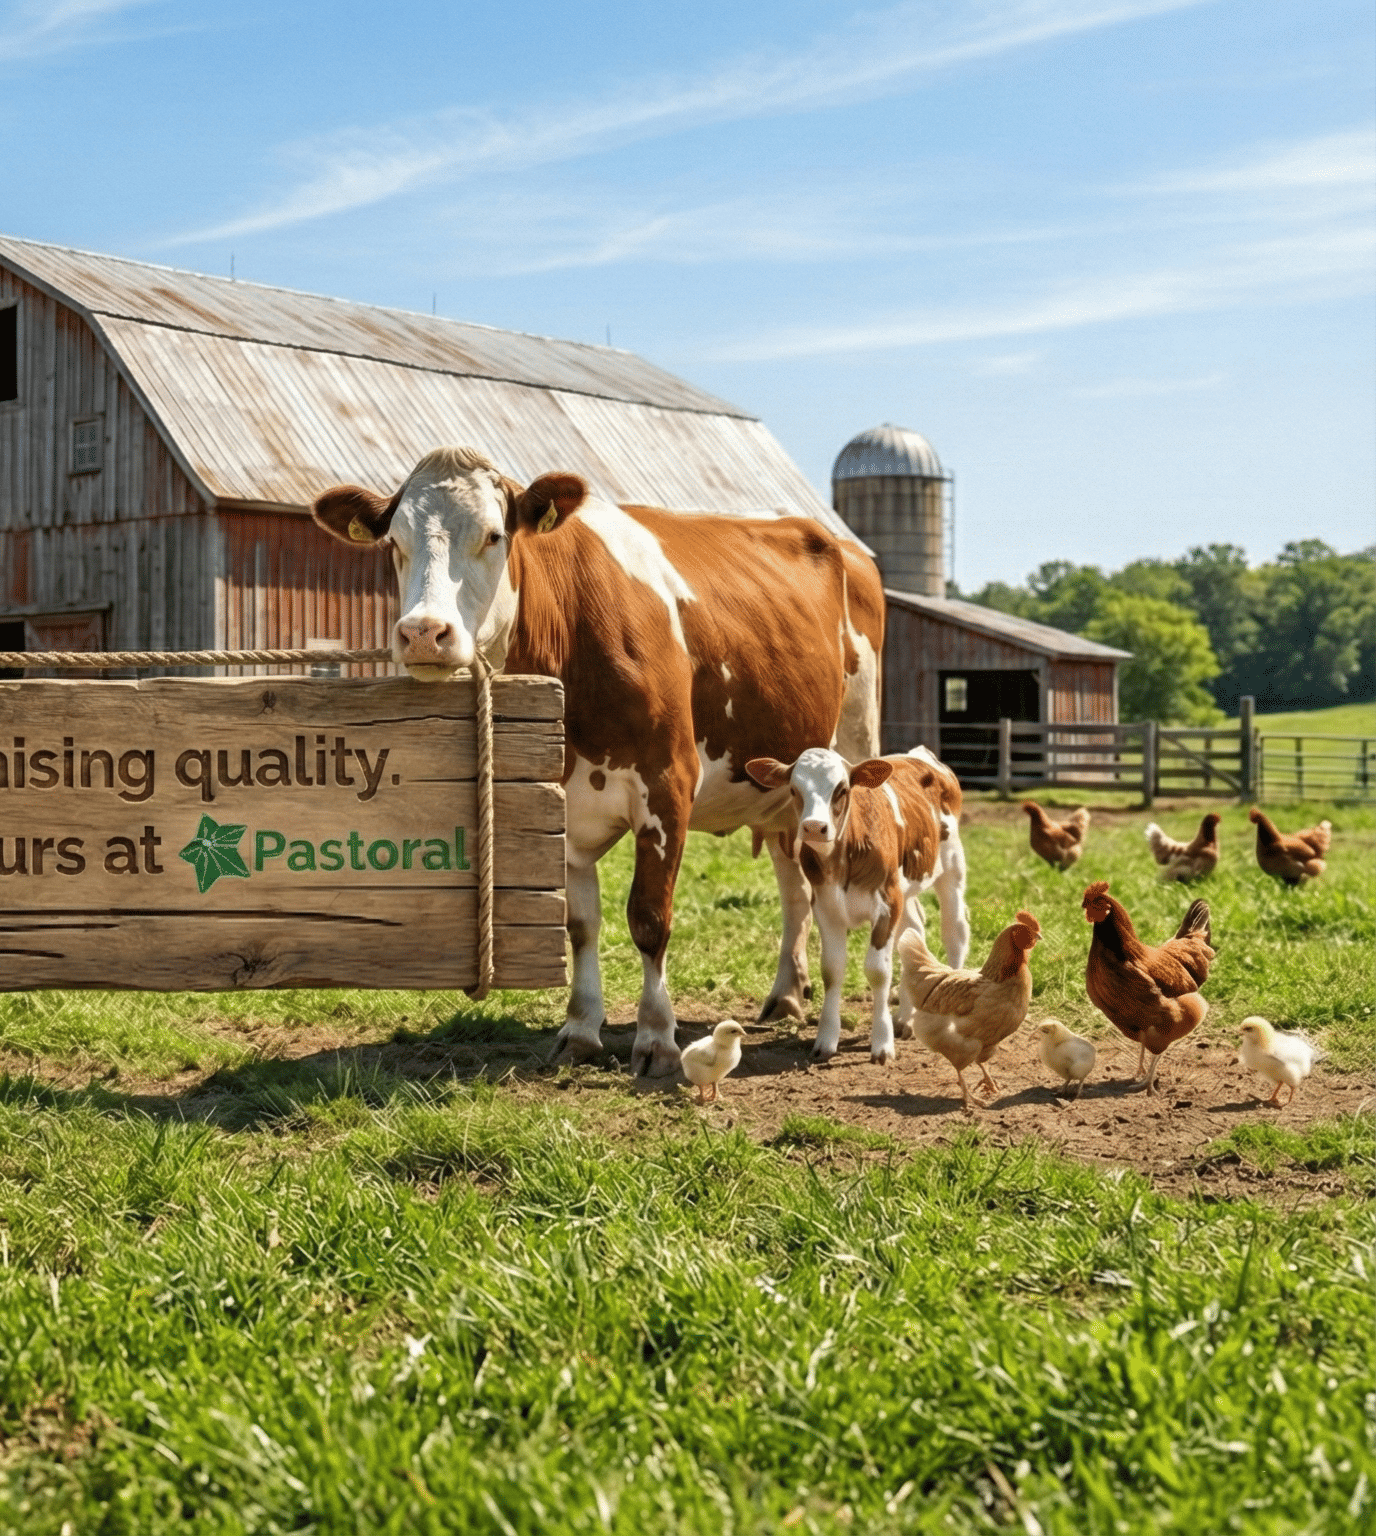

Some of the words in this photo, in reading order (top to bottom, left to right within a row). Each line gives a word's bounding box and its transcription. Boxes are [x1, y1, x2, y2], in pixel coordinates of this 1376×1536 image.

[175, 735, 402, 801] quality.
[103, 825, 165, 875] at
[255, 827, 472, 872] Pastoral
